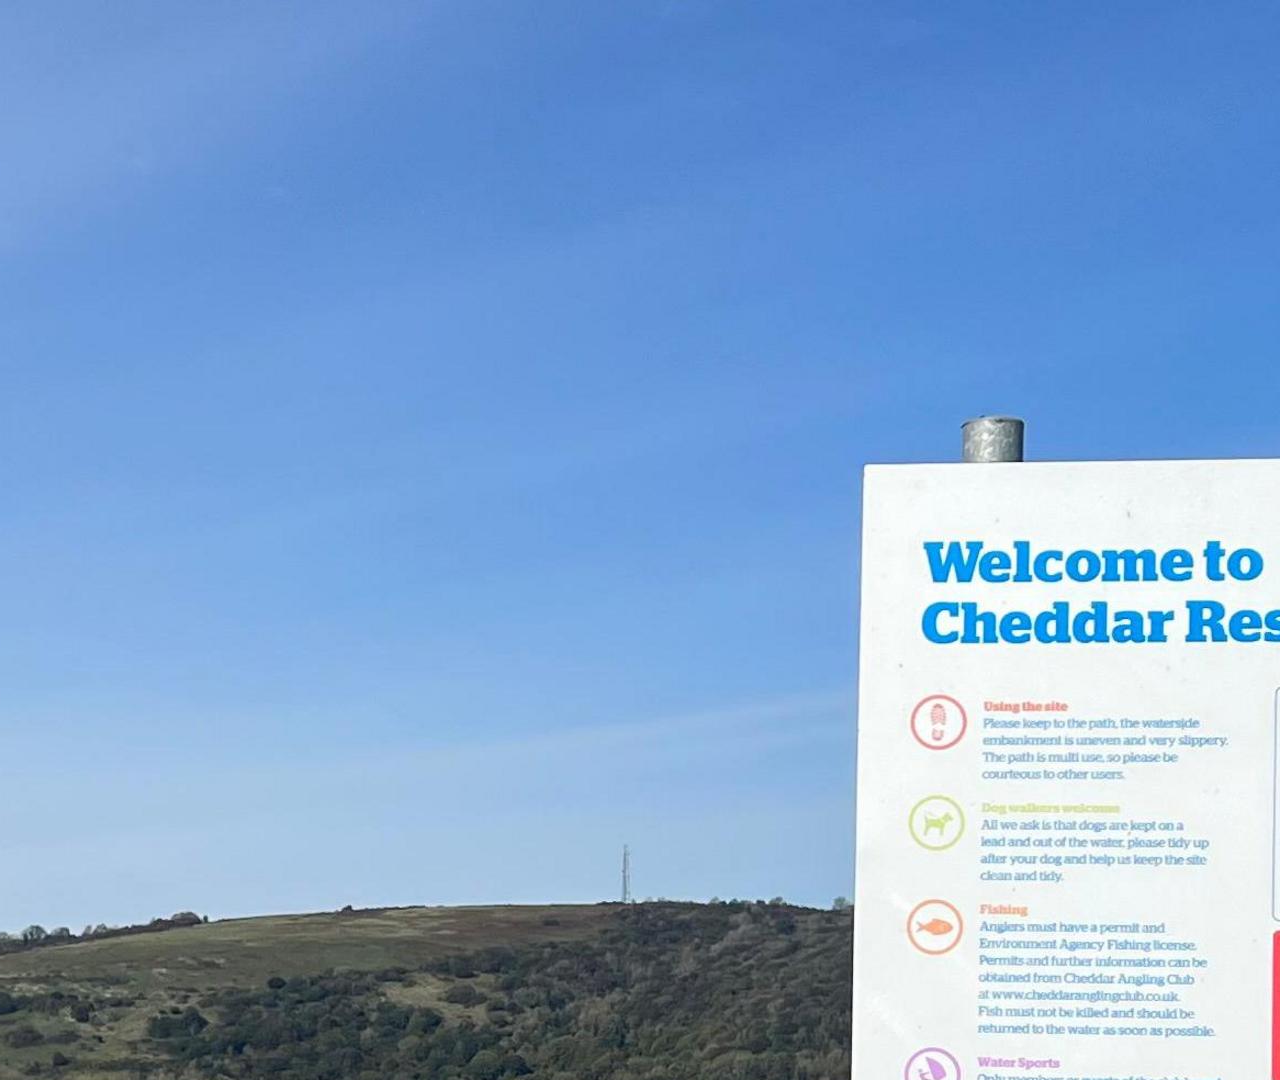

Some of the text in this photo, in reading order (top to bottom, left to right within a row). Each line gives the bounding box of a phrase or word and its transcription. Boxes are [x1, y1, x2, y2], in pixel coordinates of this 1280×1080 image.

[923, 540, 1263, 583] Welcome to
[921, 601, 1174, 644] Cheddar
[983, 701, 1068, 713] Using the site
[983, 718, 1021, 728] Please
[1022, 718, 1051, 730] keep
[1053, 719, 1065, 728] to
[1067, 718, 1087, 728] the
[1119, 718, 1140, 728] the
[1141, 718, 1199, 730] waterside
[982, 735, 1228, 747] embankment is uneven and very slippery.
[982, 751, 1006, 762] The
[1007, 751, 1034, 764] path
[1036, 752, 1046, 762] is
[1047, 752, 1079, 762] multi
[1106, 753, 1121, 762] so
[1122, 752, 1161, 764] please
[1162, 752, 1178, 762] be
[981, 769, 1041, 779] courteous
[1042, 769, 1055, 779] to
[1056, 769, 1089, 779] other
[981, 803, 1120, 815] Dog walkers welcome
[981, 819, 1183, 834] All we ask is that dogs are kept on a
[979, 904, 1028, 916] Fishing
[979, 921, 1165, 934] Anglers must have a permit and
[979, 938, 1057, 949] Environment
[1059, 938, 1104, 951] Agency
[1107, 939, 1151, 952] Fishing
[978, 990, 989, 999] at
[977, 1057, 1060, 1070] Water Sports
